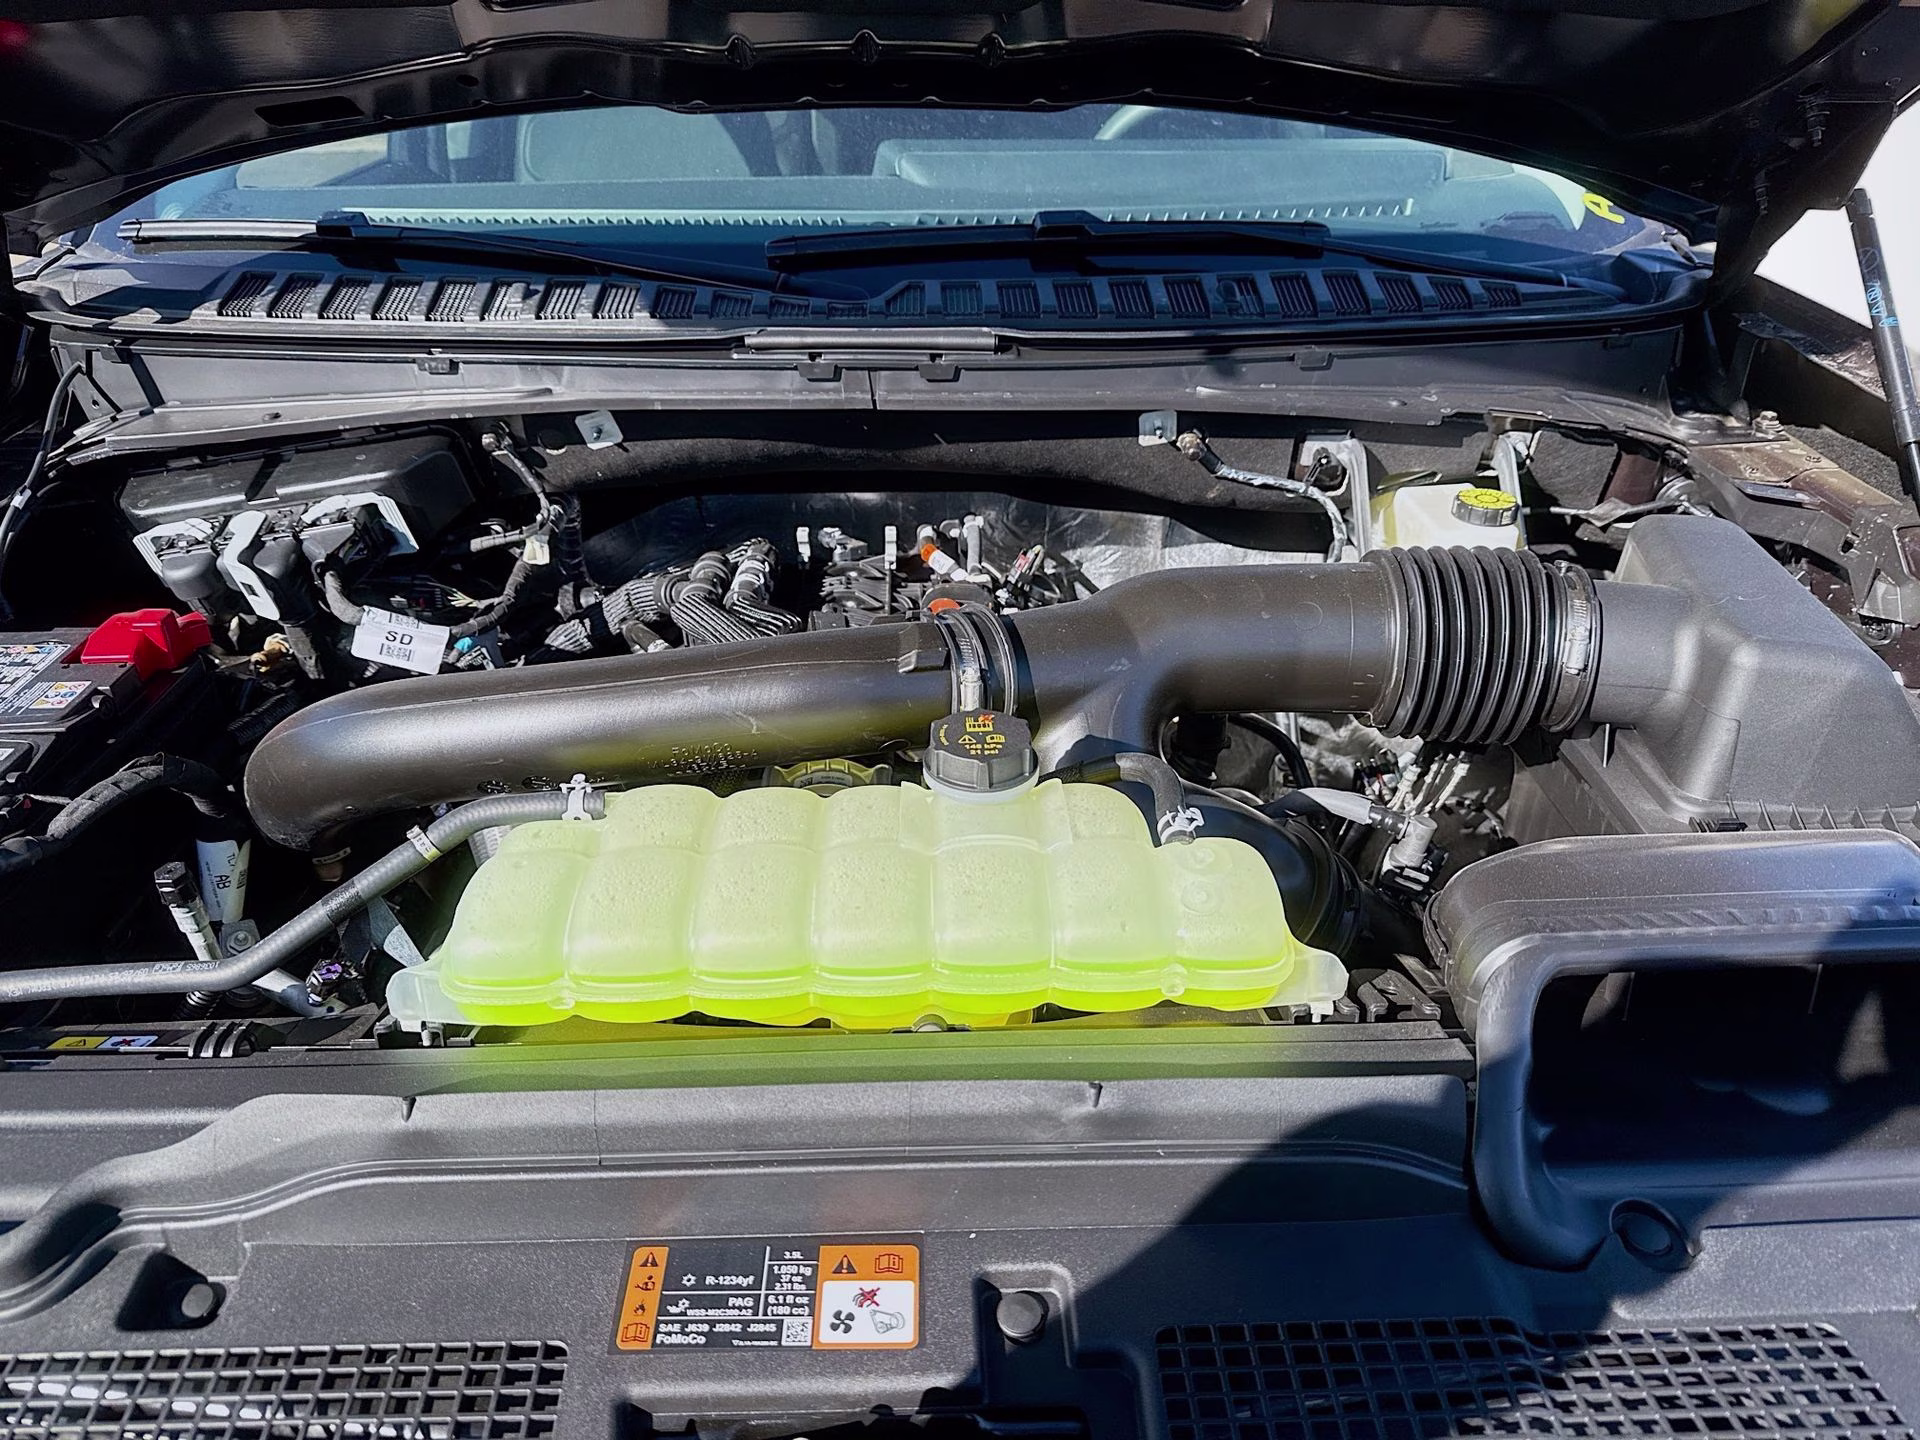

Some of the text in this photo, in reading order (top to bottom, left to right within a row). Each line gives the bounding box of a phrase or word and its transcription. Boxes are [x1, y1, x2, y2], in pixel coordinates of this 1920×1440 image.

[385, 630, 413, 645] SD
[214, 874, 232, 890] AB
[783, 1251, 804, 1259] 3.5L
[773, 1265, 813, 1276] 1.050 kg
[705, 1275, 756, 1287] R-1234yf
[793, 1283, 807, 1291] lbs
[727, 1296, 754, 1307] PAG
[767, 1295, 810, 1304] 6.1 fl oz
[767, 1306, 810, 1316] (180 cc)
[658, 1323, 777, 1332] SAE J639 J2842 J2845
[655, 1333, 707, 1345] FoMoCo
